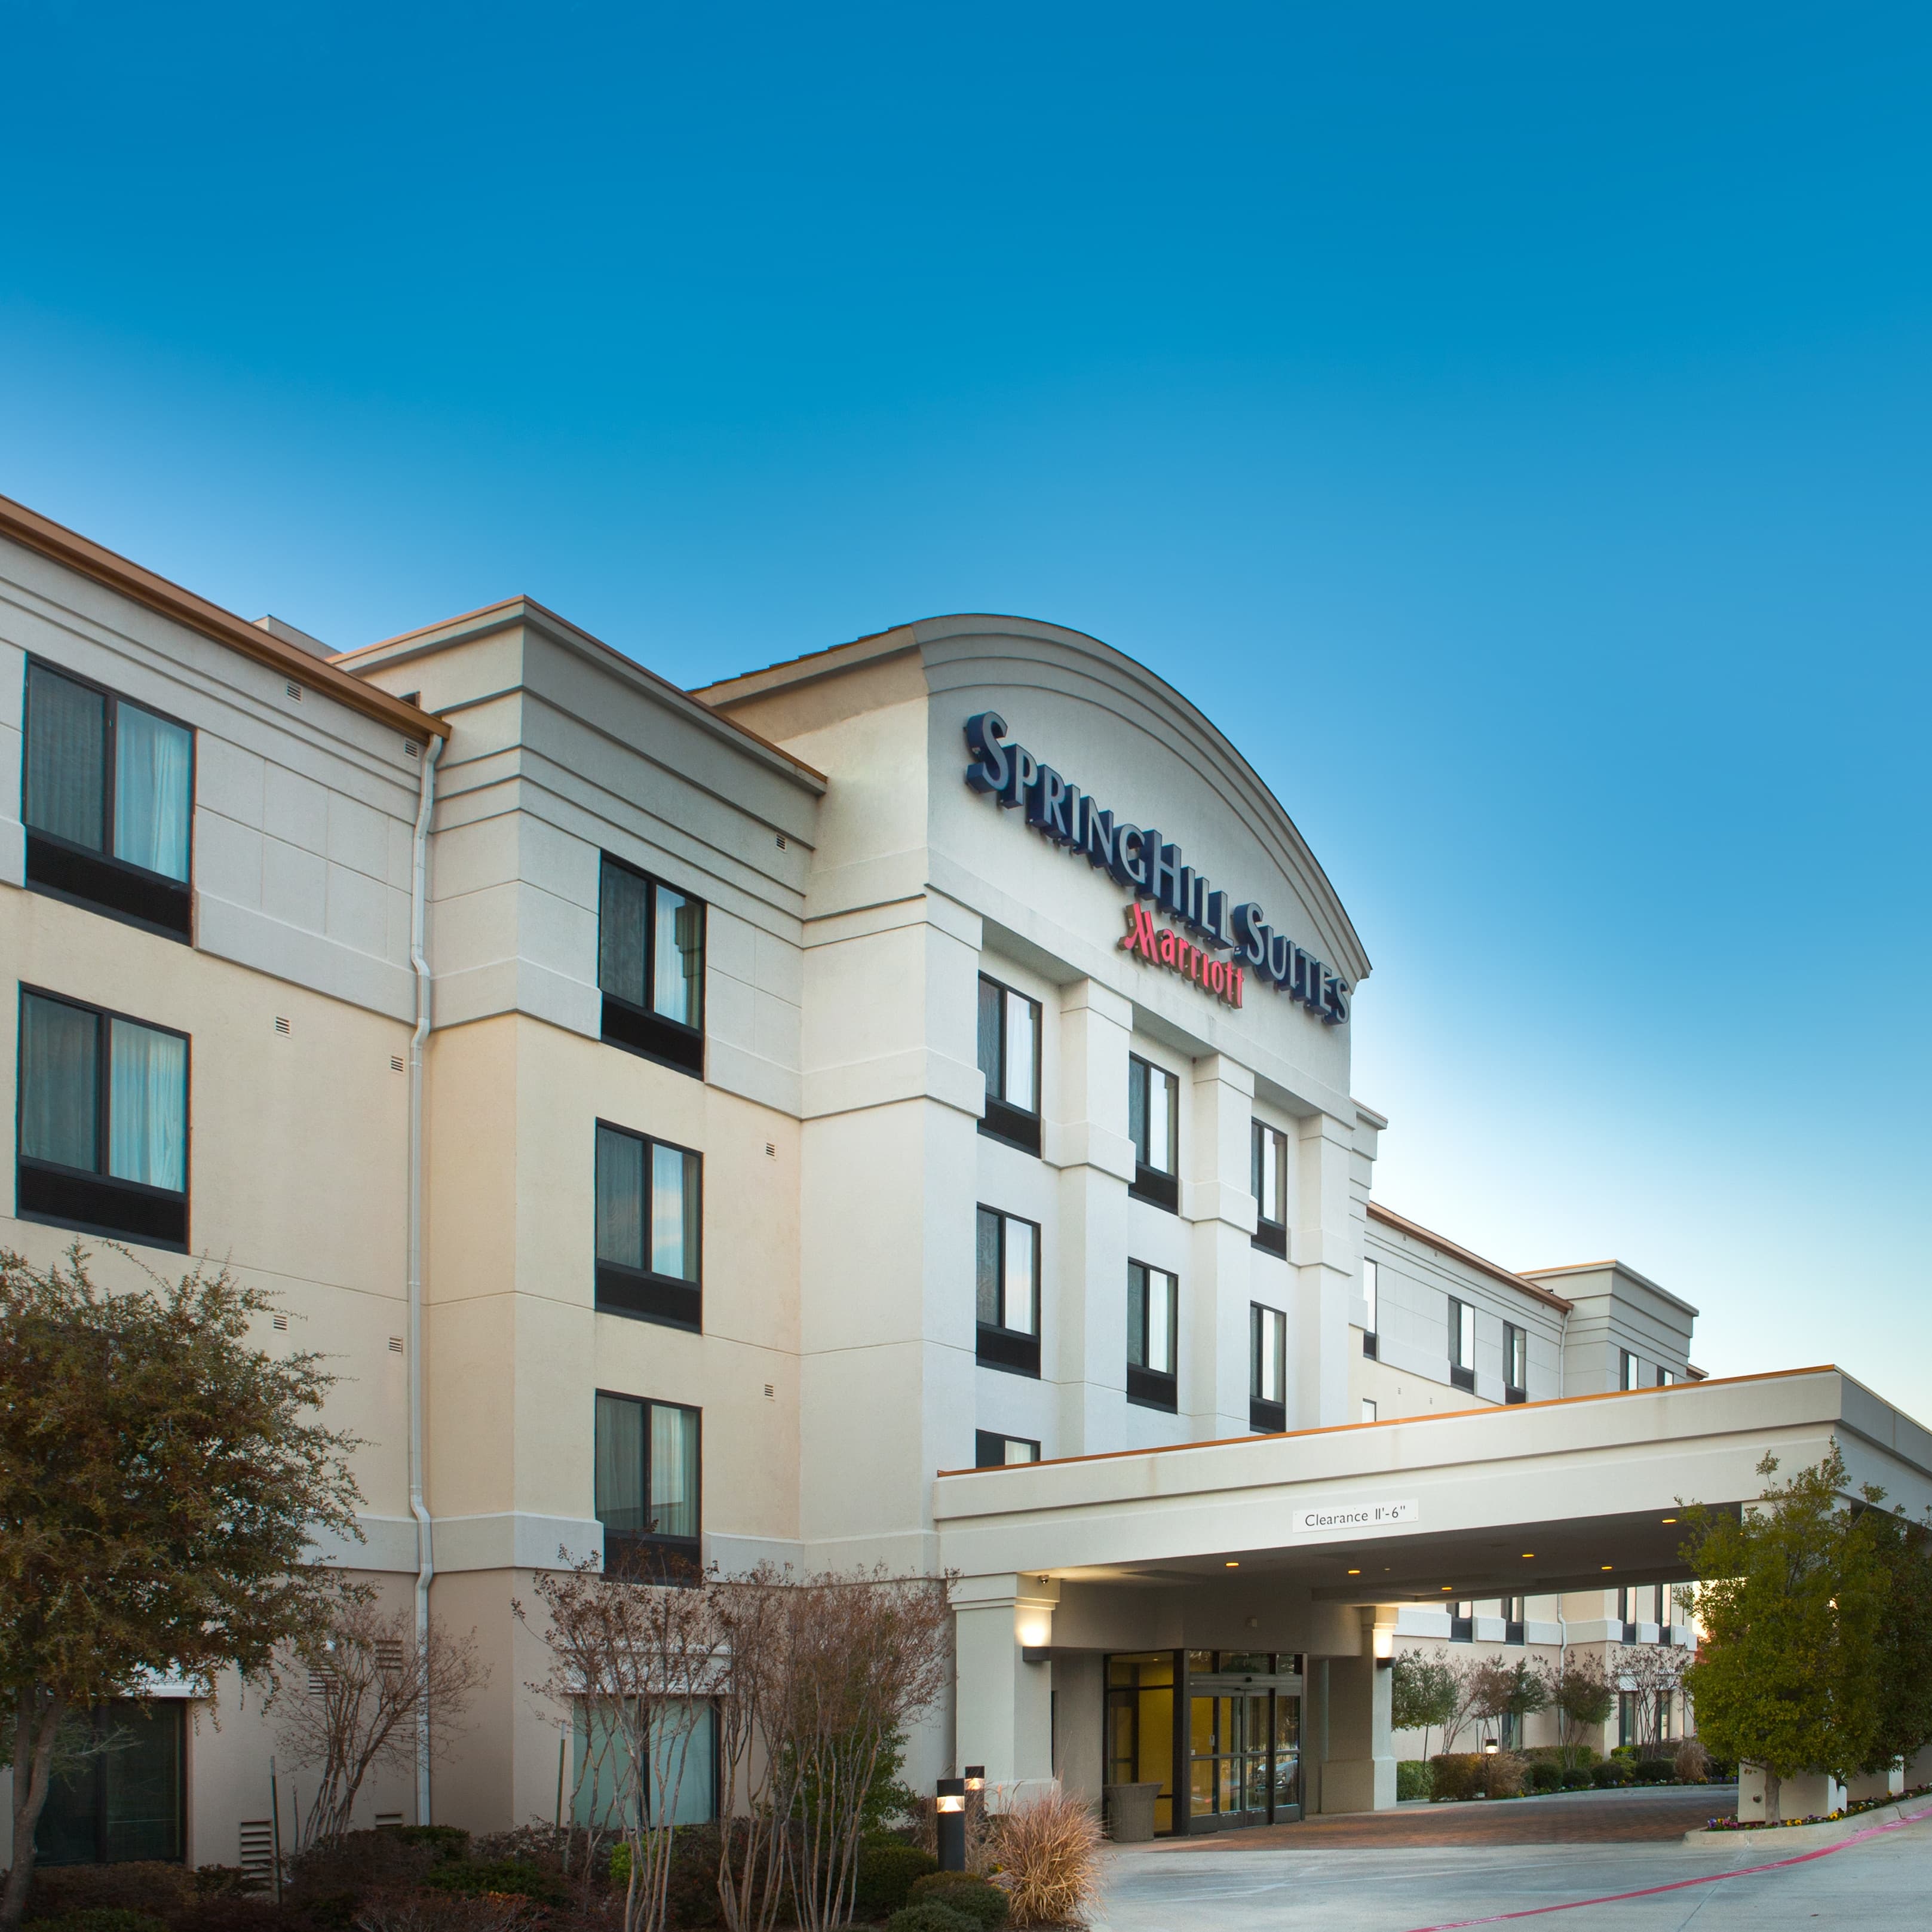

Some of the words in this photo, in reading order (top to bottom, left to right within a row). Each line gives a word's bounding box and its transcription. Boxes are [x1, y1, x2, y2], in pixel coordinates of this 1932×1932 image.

[967, 711, 1234, 950] SPRINGHILL
[1232, 902, 1350, 1025] SUITES
[1118, 903, 1244, 1009] Marriott
[1305, 1512, 1368, 1526] Clearance
[1375, 1505, 1406, 1520] 11'-6"
